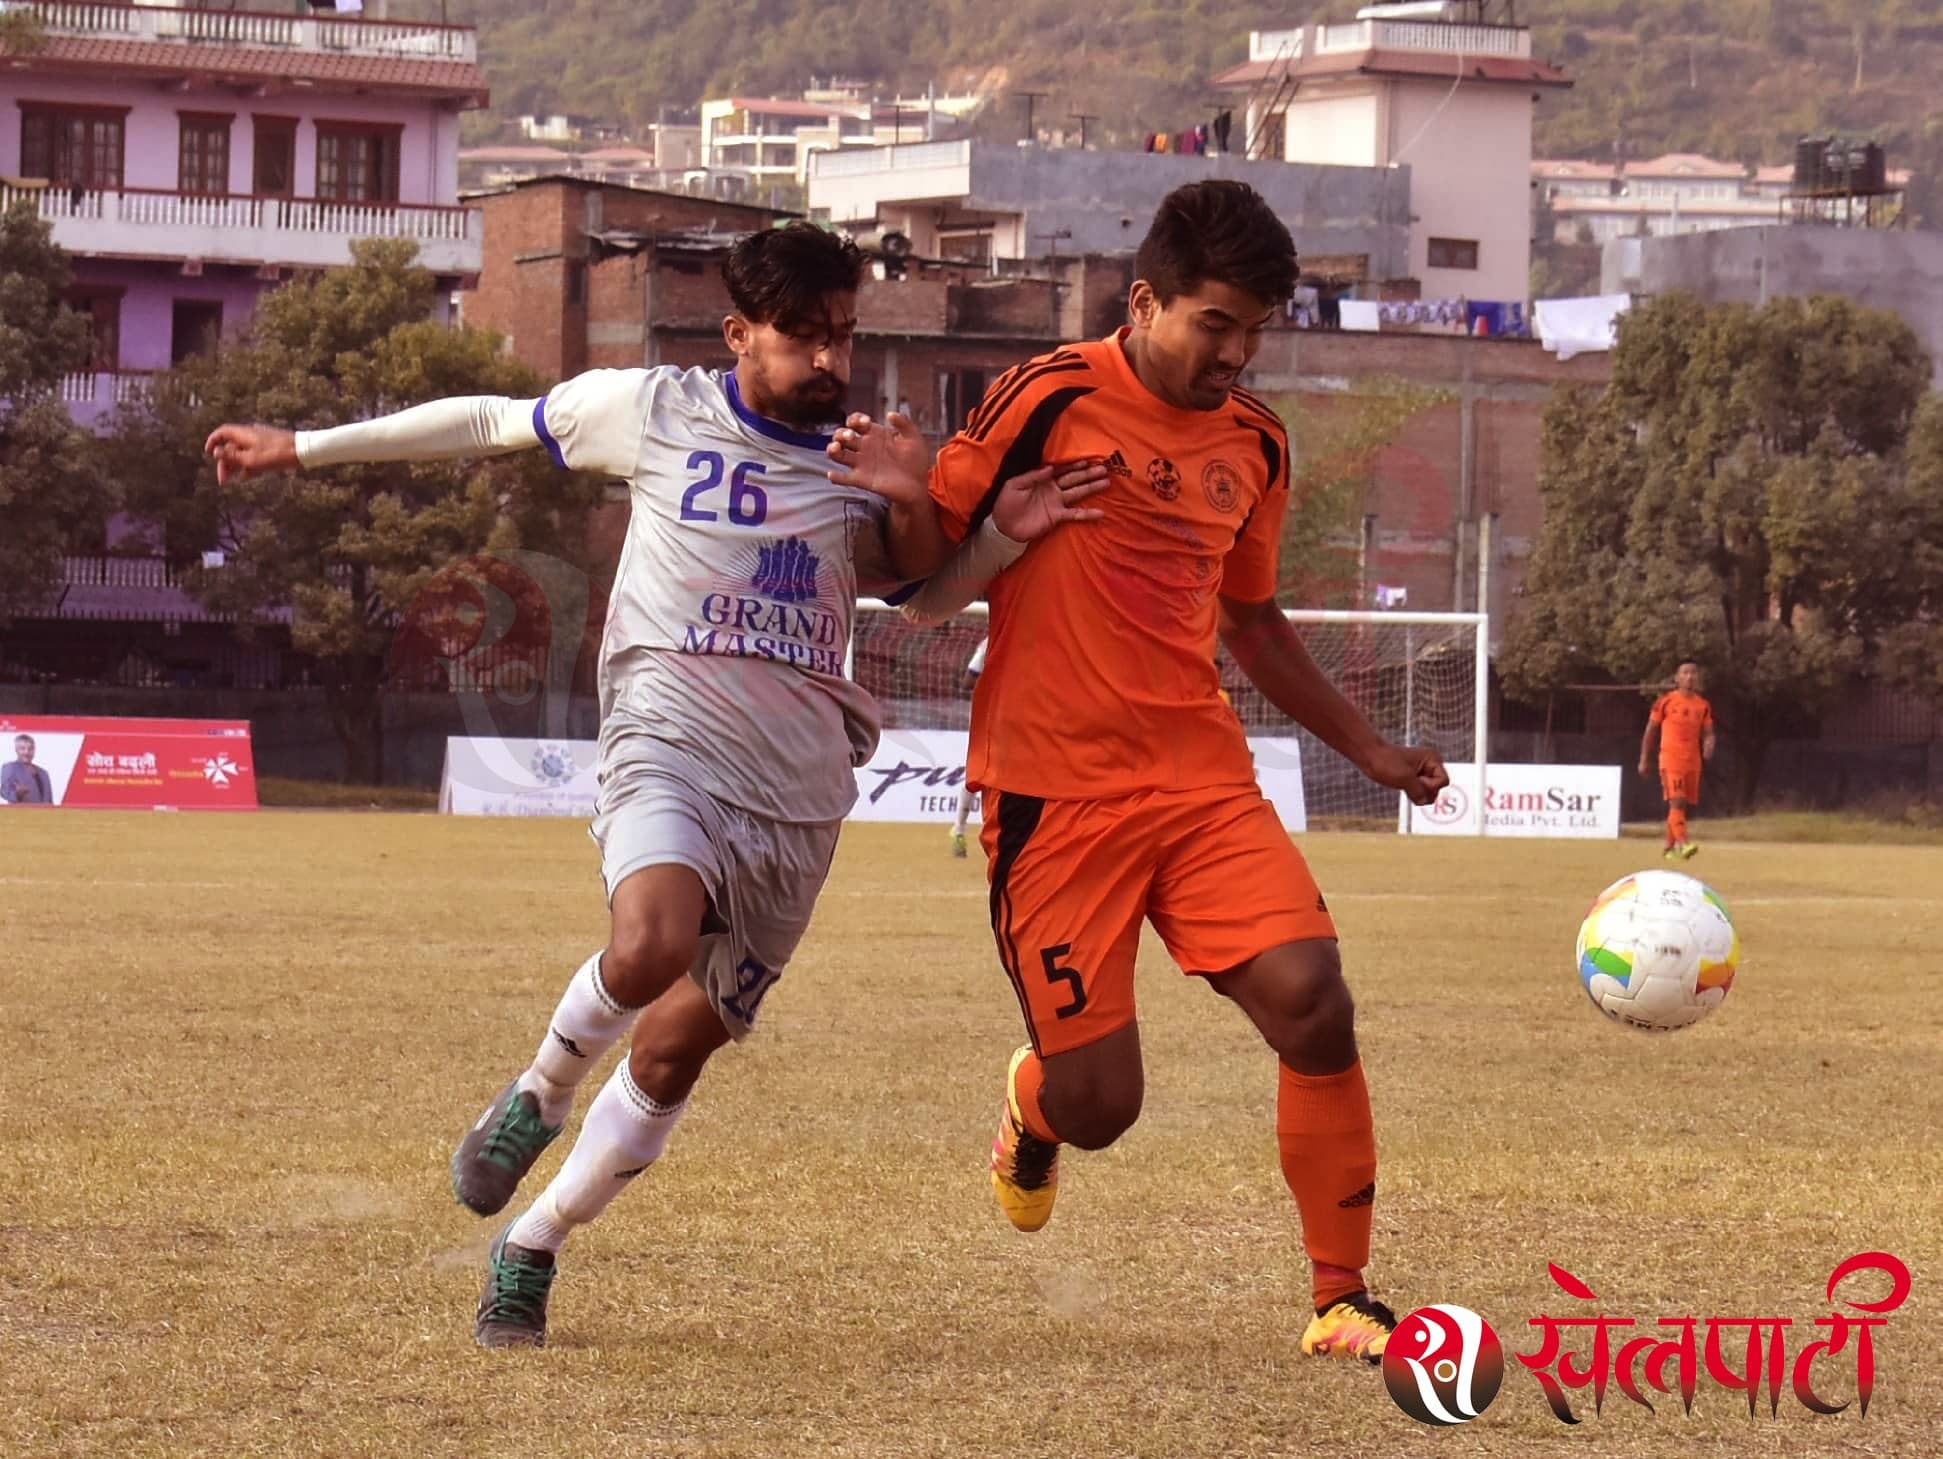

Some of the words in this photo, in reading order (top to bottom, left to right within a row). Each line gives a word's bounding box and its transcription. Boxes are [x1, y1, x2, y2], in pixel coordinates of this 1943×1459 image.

[680, 450, 767, 527] 26
[702, 592, 837, 647] GRAND
[869, 760, 966, 804] pu
[1040, 942, 1088, 1020] 5
